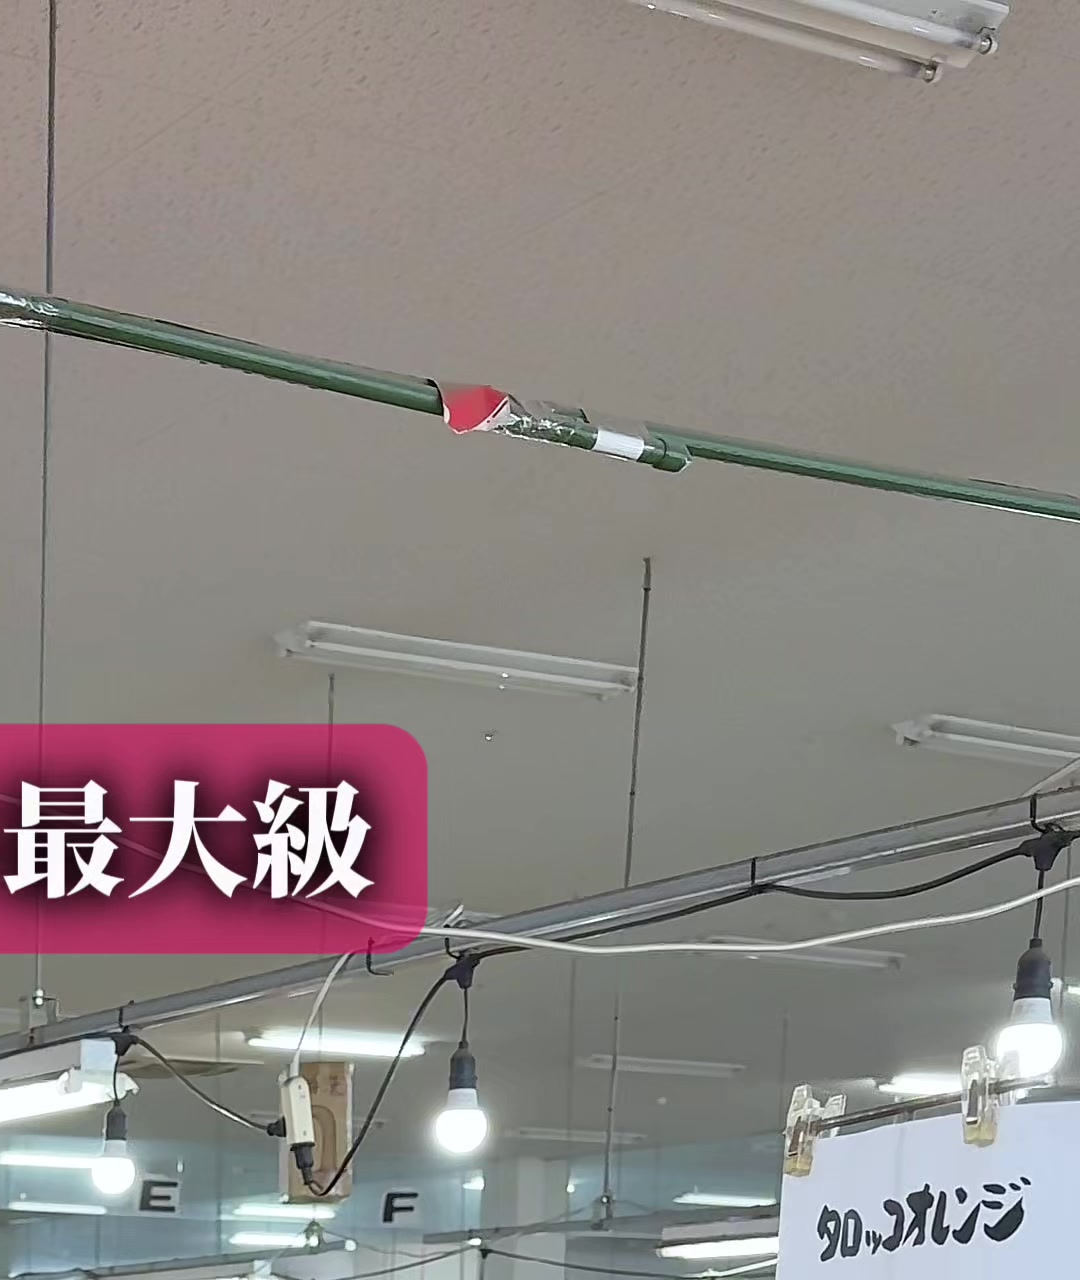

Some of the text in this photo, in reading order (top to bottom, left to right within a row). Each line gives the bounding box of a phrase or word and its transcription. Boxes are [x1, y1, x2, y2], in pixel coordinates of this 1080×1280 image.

[140, 1179, 179, 1212] E
[383, 1191, 419, 1222] F
[817, 1177, 1032, 1262] タロッコオレンジ
